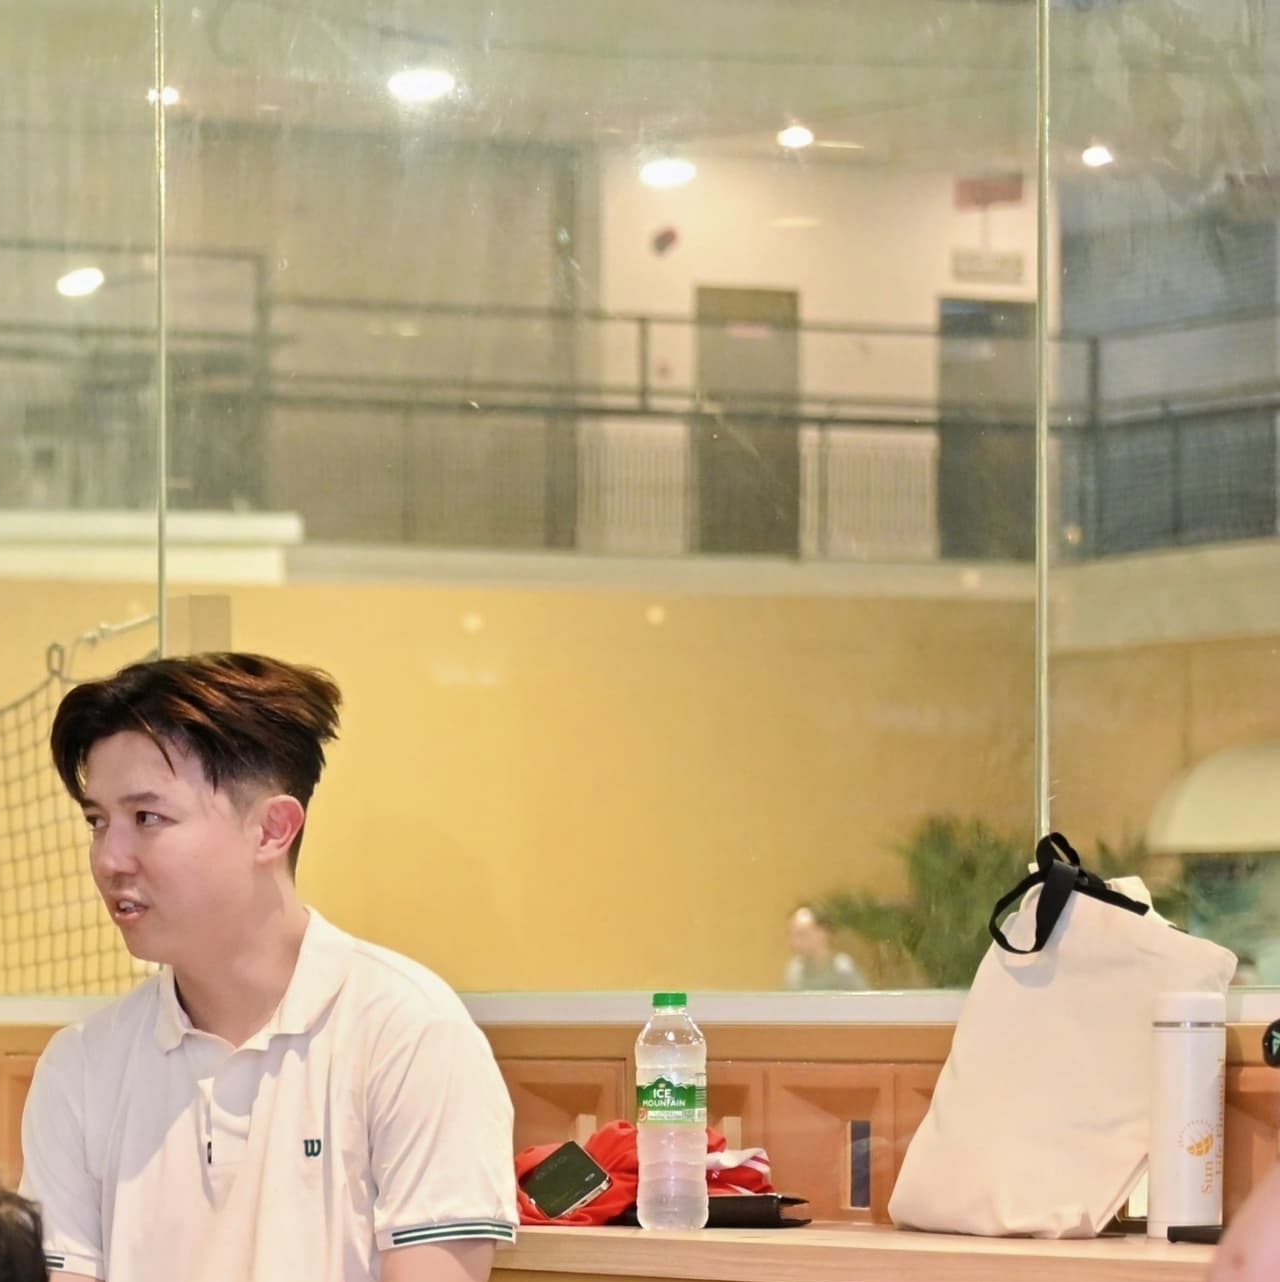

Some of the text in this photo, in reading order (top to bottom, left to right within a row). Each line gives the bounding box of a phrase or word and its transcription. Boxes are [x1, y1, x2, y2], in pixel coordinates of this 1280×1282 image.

[653, 1088, 672, 1099] ICE
[642, 1098, 686, 1108] MOUNTAIN
[1201, 1160, 1214, 1194] Sun
